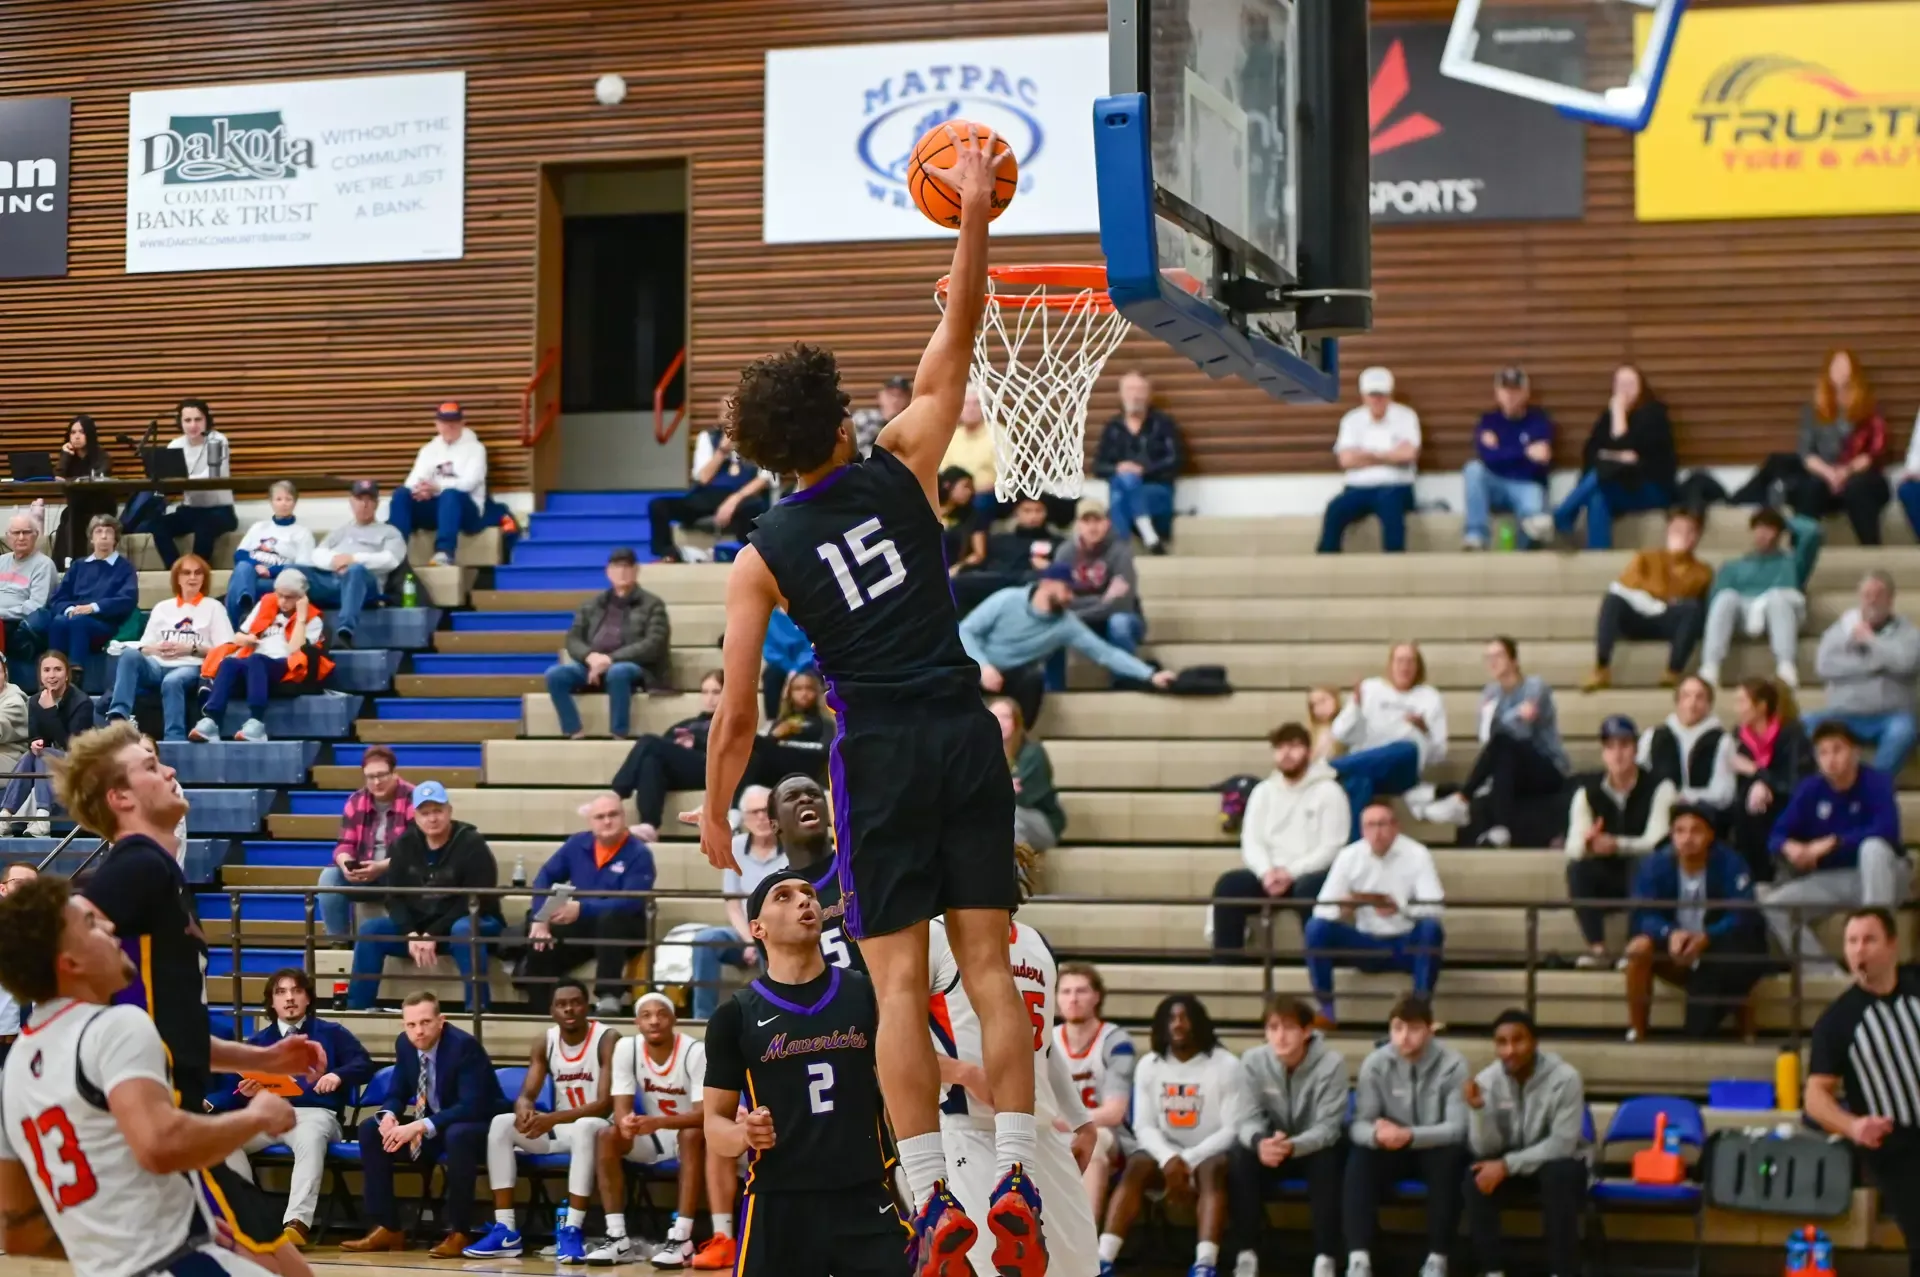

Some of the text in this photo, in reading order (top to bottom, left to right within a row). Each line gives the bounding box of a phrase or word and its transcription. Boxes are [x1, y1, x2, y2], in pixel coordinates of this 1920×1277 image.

[862, 65, 1039, 115] MATPAC
[321, 116, 451, 146] WITHOUT THE
[1687, 103, 1920, 145] TRUST
[140, 118, 318, 181] Dakota
[164, 184, 290, 206] COMMUNITY
[400, 168, 445, 188] JUST
[136, 202, 318, 231] BANK & TRUST
[816, 516, 907, 612] 15
[760, 1025, 868, 1062] Mavericks
[565, 1086, 586, 1110] 11
[807, 1062, 835, 1114] 2
[21, 1105, 99, 1214] 13
